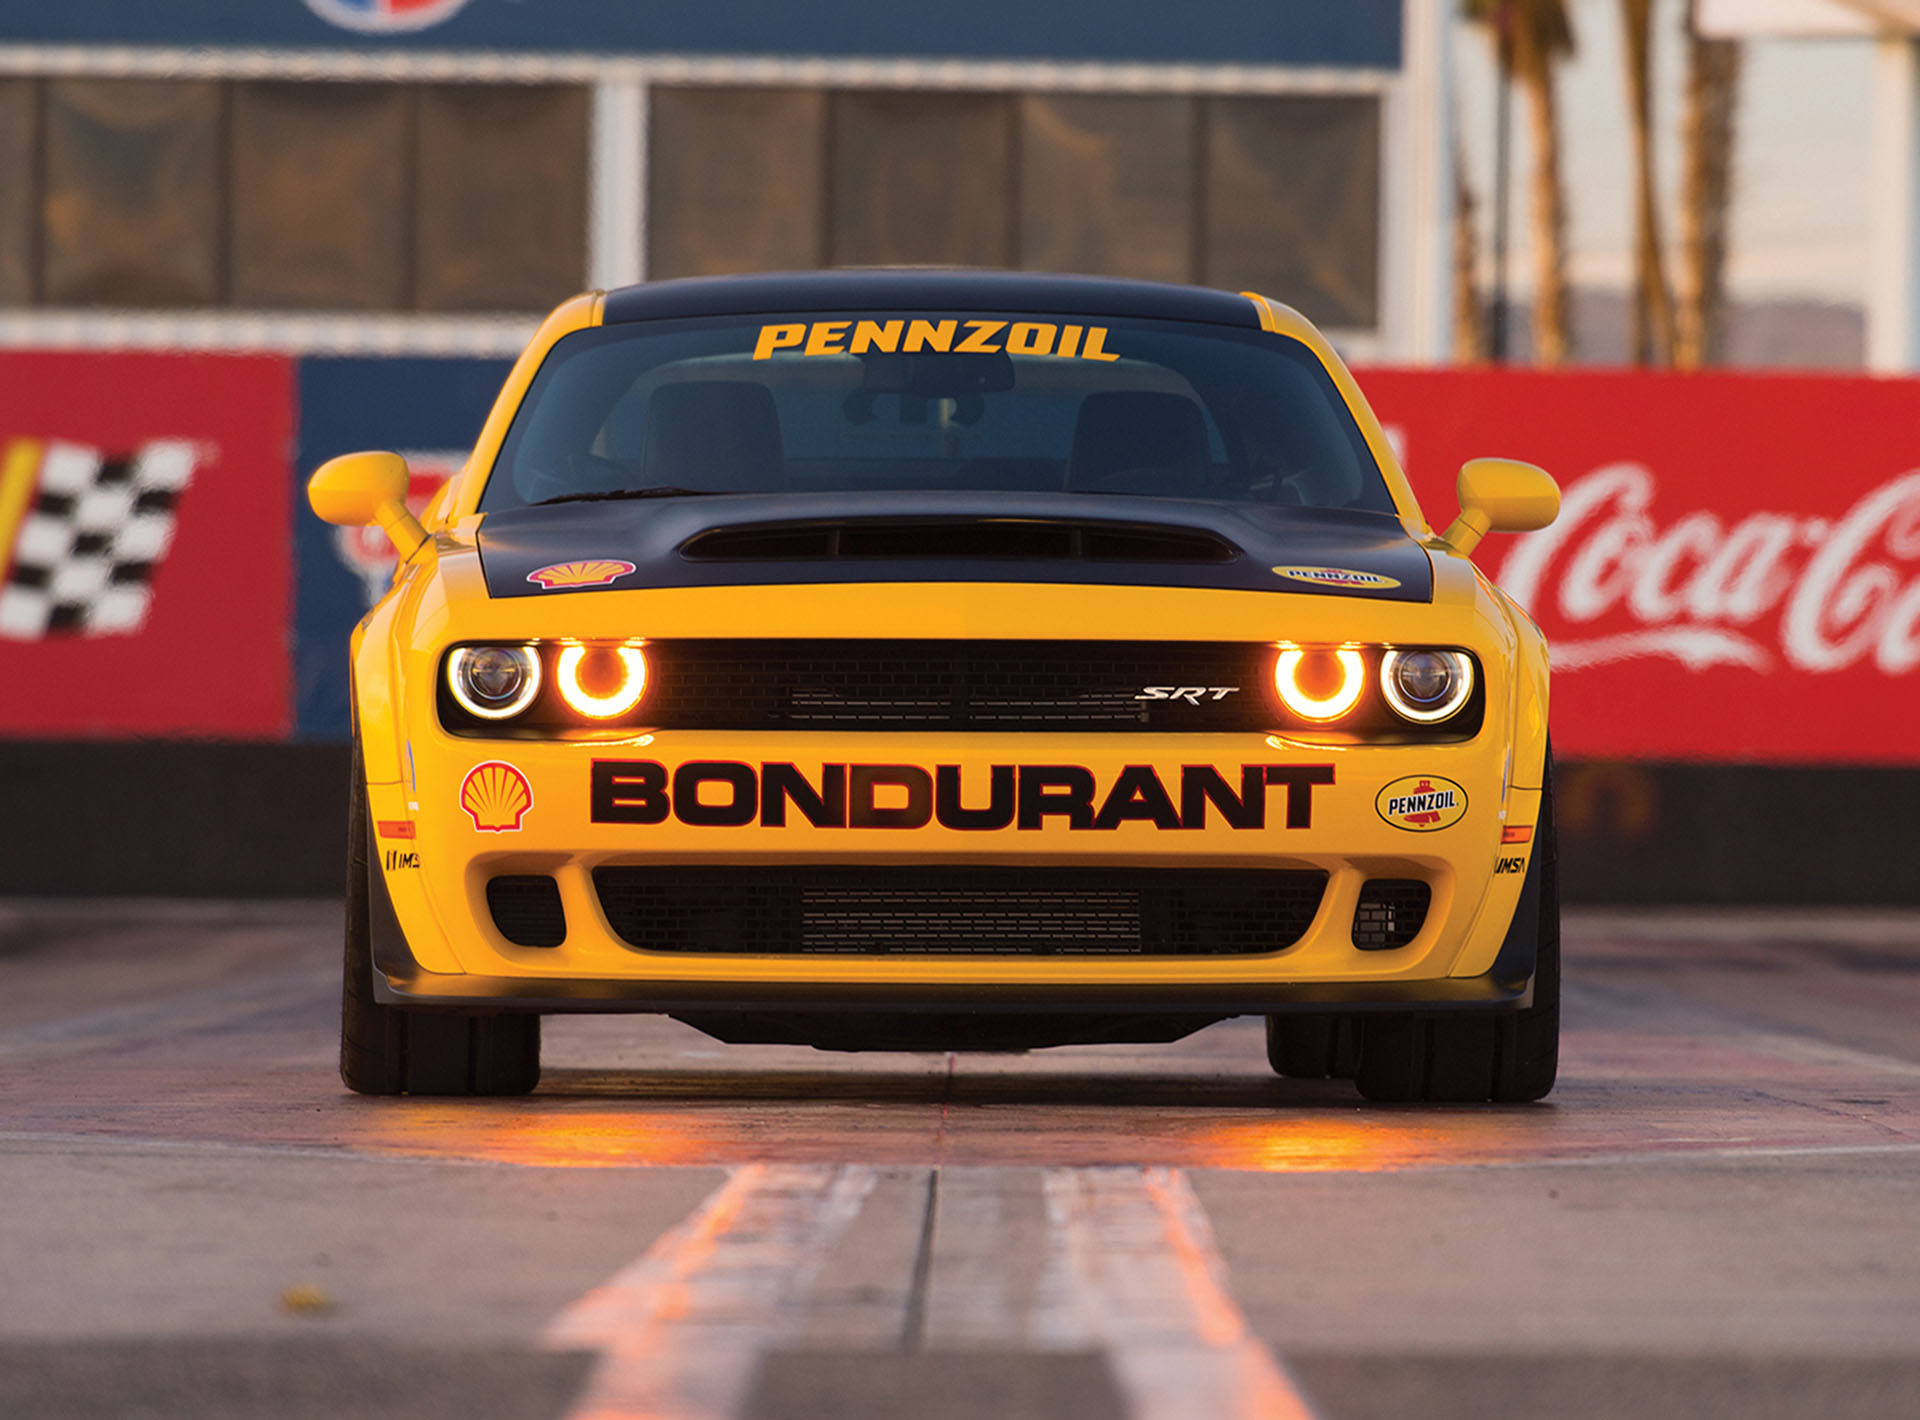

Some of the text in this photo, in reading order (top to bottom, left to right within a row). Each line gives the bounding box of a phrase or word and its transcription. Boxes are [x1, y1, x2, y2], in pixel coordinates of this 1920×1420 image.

[753, 320, 1120, 361] PENNZOIL
[1134, 686, 1240, 706] SRT
[590, 758, 1335, 831] BONDURANT
[1388, 790, 1456, 816] PENNZOIL
